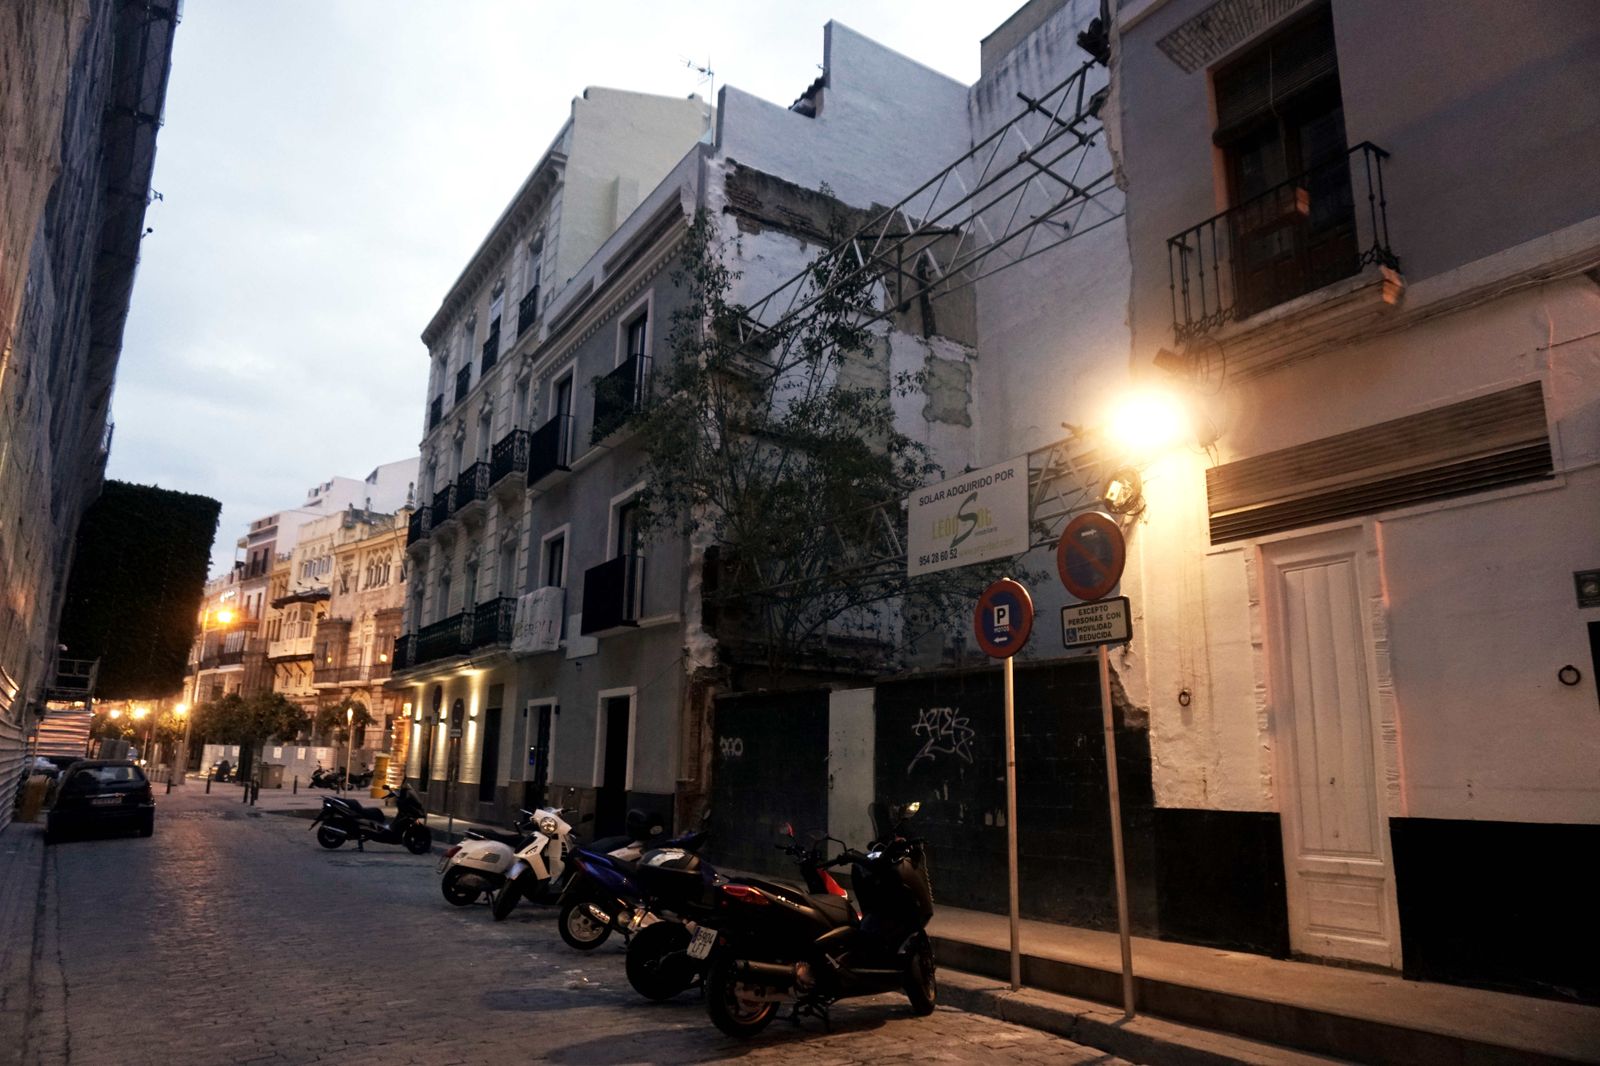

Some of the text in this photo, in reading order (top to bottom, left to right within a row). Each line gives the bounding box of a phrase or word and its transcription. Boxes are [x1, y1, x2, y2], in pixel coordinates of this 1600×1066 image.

[919, 469, 1014, 506] SOLAR ADQUIRIDO POR
[919, 553, 930, 567] 954
[931, 551, 940, 564] 28
[949, 548, 958, 560] 52
[997, 608, 1006, 624] P
[1078, 605, 1109, 616] EXCEPTO
[1068, 611, 1121, 626] PERSONAS CON
[1077, 622, 1112, 632] MOVILIDAD
[1079, 631, 1112, 641] REDUCIDA
